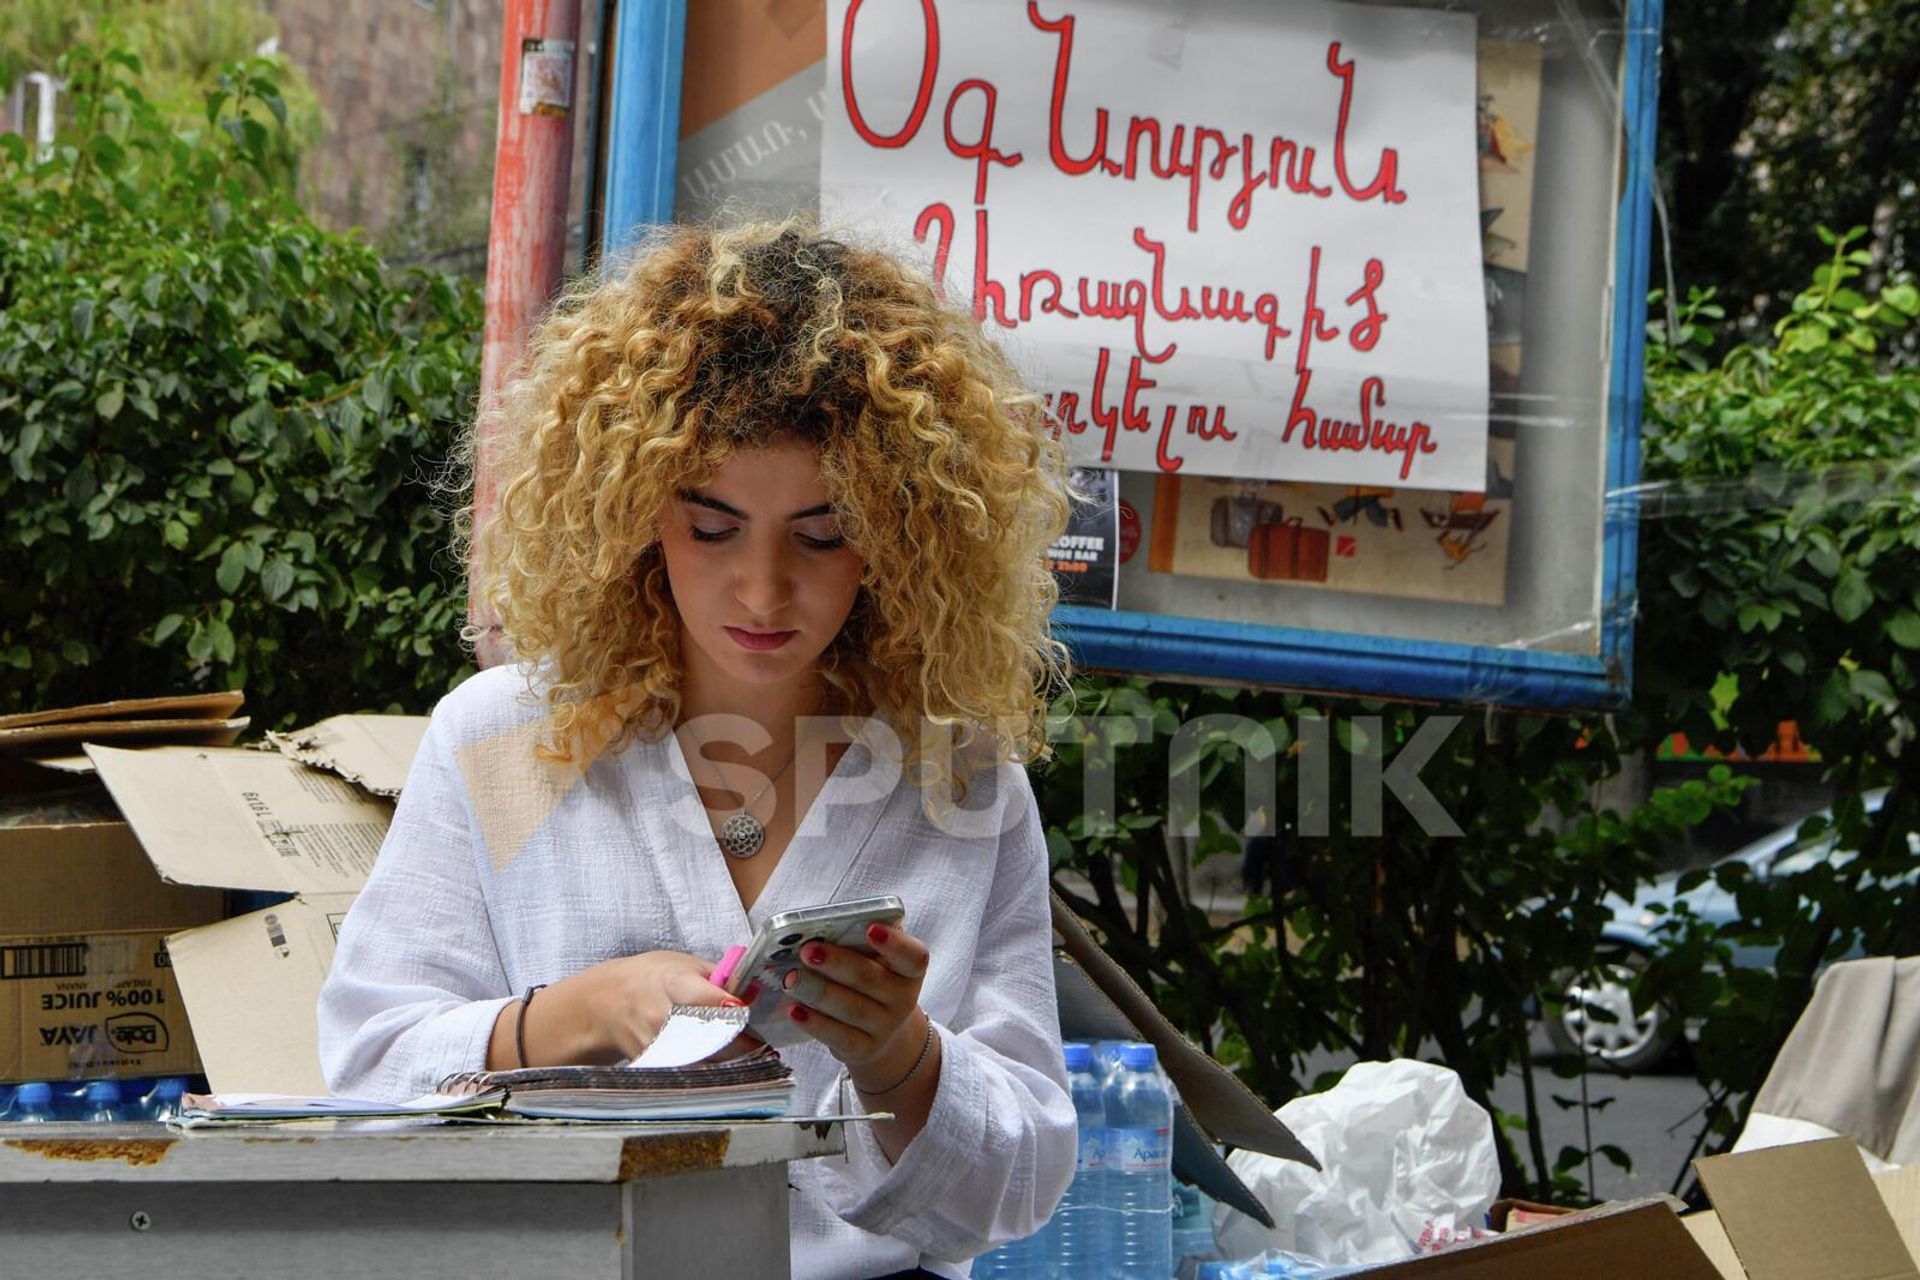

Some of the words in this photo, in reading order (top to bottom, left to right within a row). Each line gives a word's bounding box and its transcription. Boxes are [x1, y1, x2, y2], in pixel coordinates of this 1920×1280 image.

[1281, 368, 1438, 480] համար
[42, 992, 102, 1010] JUICE
[106, 988, 165, 1007] 100%
[115, 1025, 157, 1045] Dole
